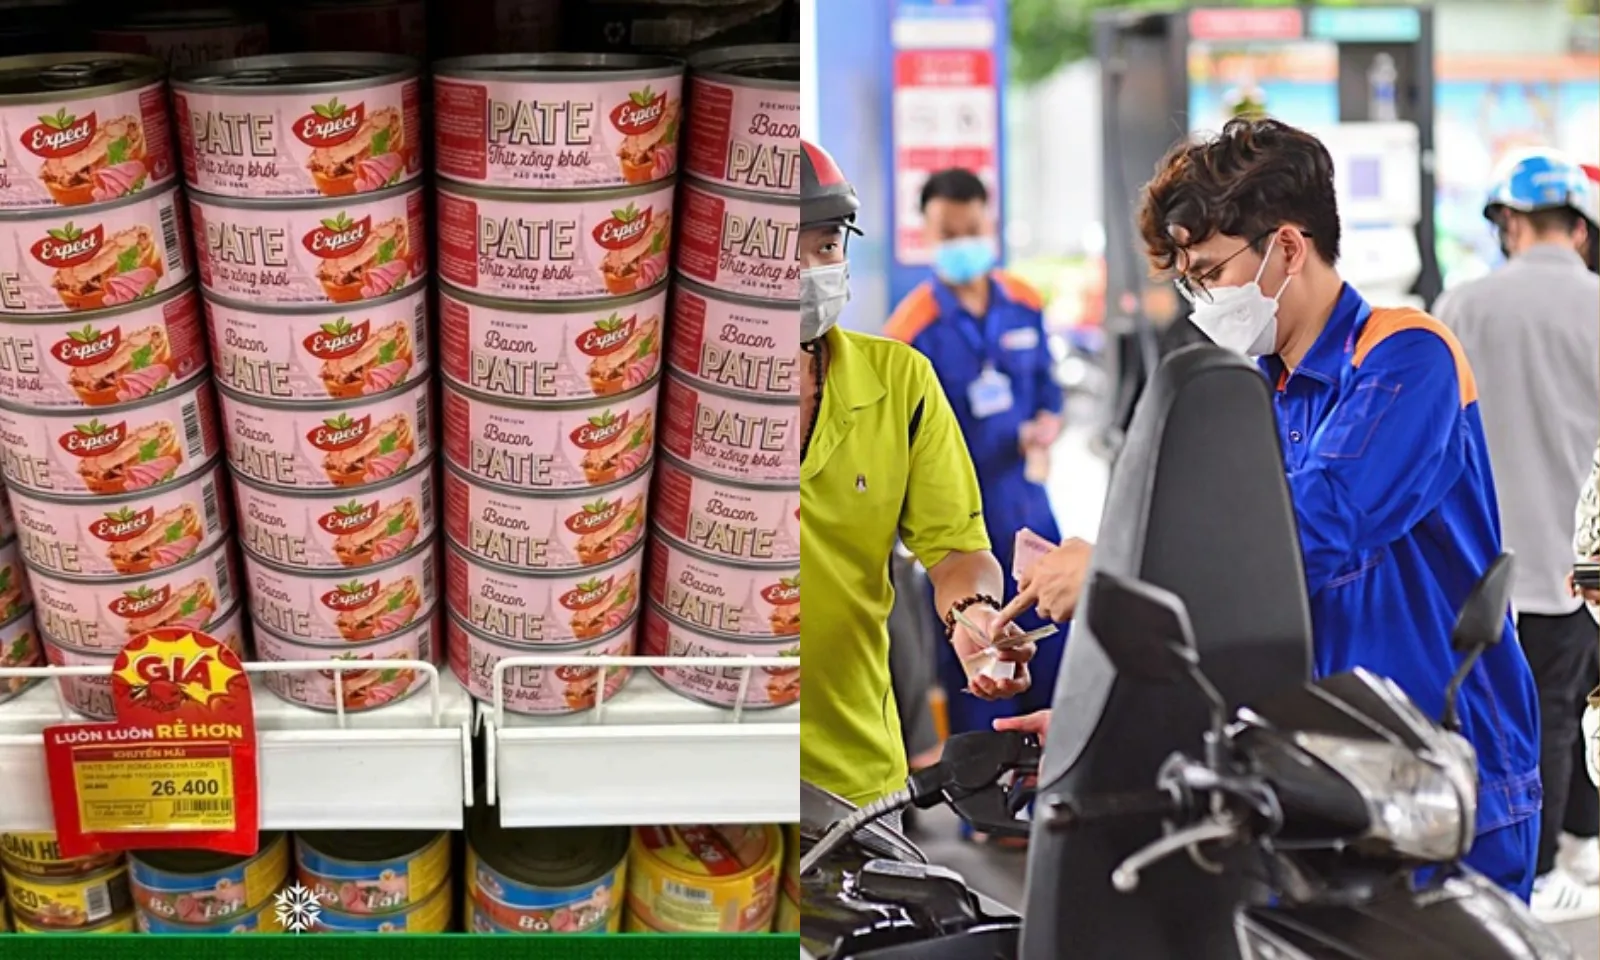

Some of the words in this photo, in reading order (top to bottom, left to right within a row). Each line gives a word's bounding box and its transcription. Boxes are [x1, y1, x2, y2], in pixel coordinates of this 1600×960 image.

[303, 112, 358, 139] Expect
[488, 99, 593, 146] PATE
[618, 100, 662, 127] Expect
[31, 119, 91, 150] Expect
[312, 224, 365, 250] Expect
[478, 213, 576, 260] PATE
[601, 217, 646, 243] Expect
[721, 210, 800, 262] PAT
[40, 233, 97, 260] Expect
[60, 332, 115, 360] Expect
[225, 327, 268, 353] Bacon
[312, 327, 364, 352] Expect
[484, 329, 537, 354] Bacon
[584, 326, 630, 350] Expect
[719, 323, 776, 349] Bacon
[0, 337, 40, 375] TE
[700, 341, 796, 392] PATE
[470, 350, 559, 397] PATE
[235, 418, 274, 444] Bacon
[315, 421, 364, 444] Expect
[483, 423, 533, 447] Bacon
[695, 403, 789, 452] PATE
[2, 448, 55, 489] ATE
[470, 440, 554, 486] PATE
[482, 506, 531, 531] Bacon
[705, 498, 759, 523] Bacon
[687, 510, 777, 559] PATE
[480, 583, 526, 607] Bacon
[679, 570, 726, 598] Bacon
[132, 651, 213, 692] GIÁ
[55, 728, 103, 745] LUÔN
[107, 726, 154, 741] LUÔN
[156, 718, 188, 739] RẺ
[192, 724, 243, 739] HƠN
[151, 778, 219, 797] 26.400
